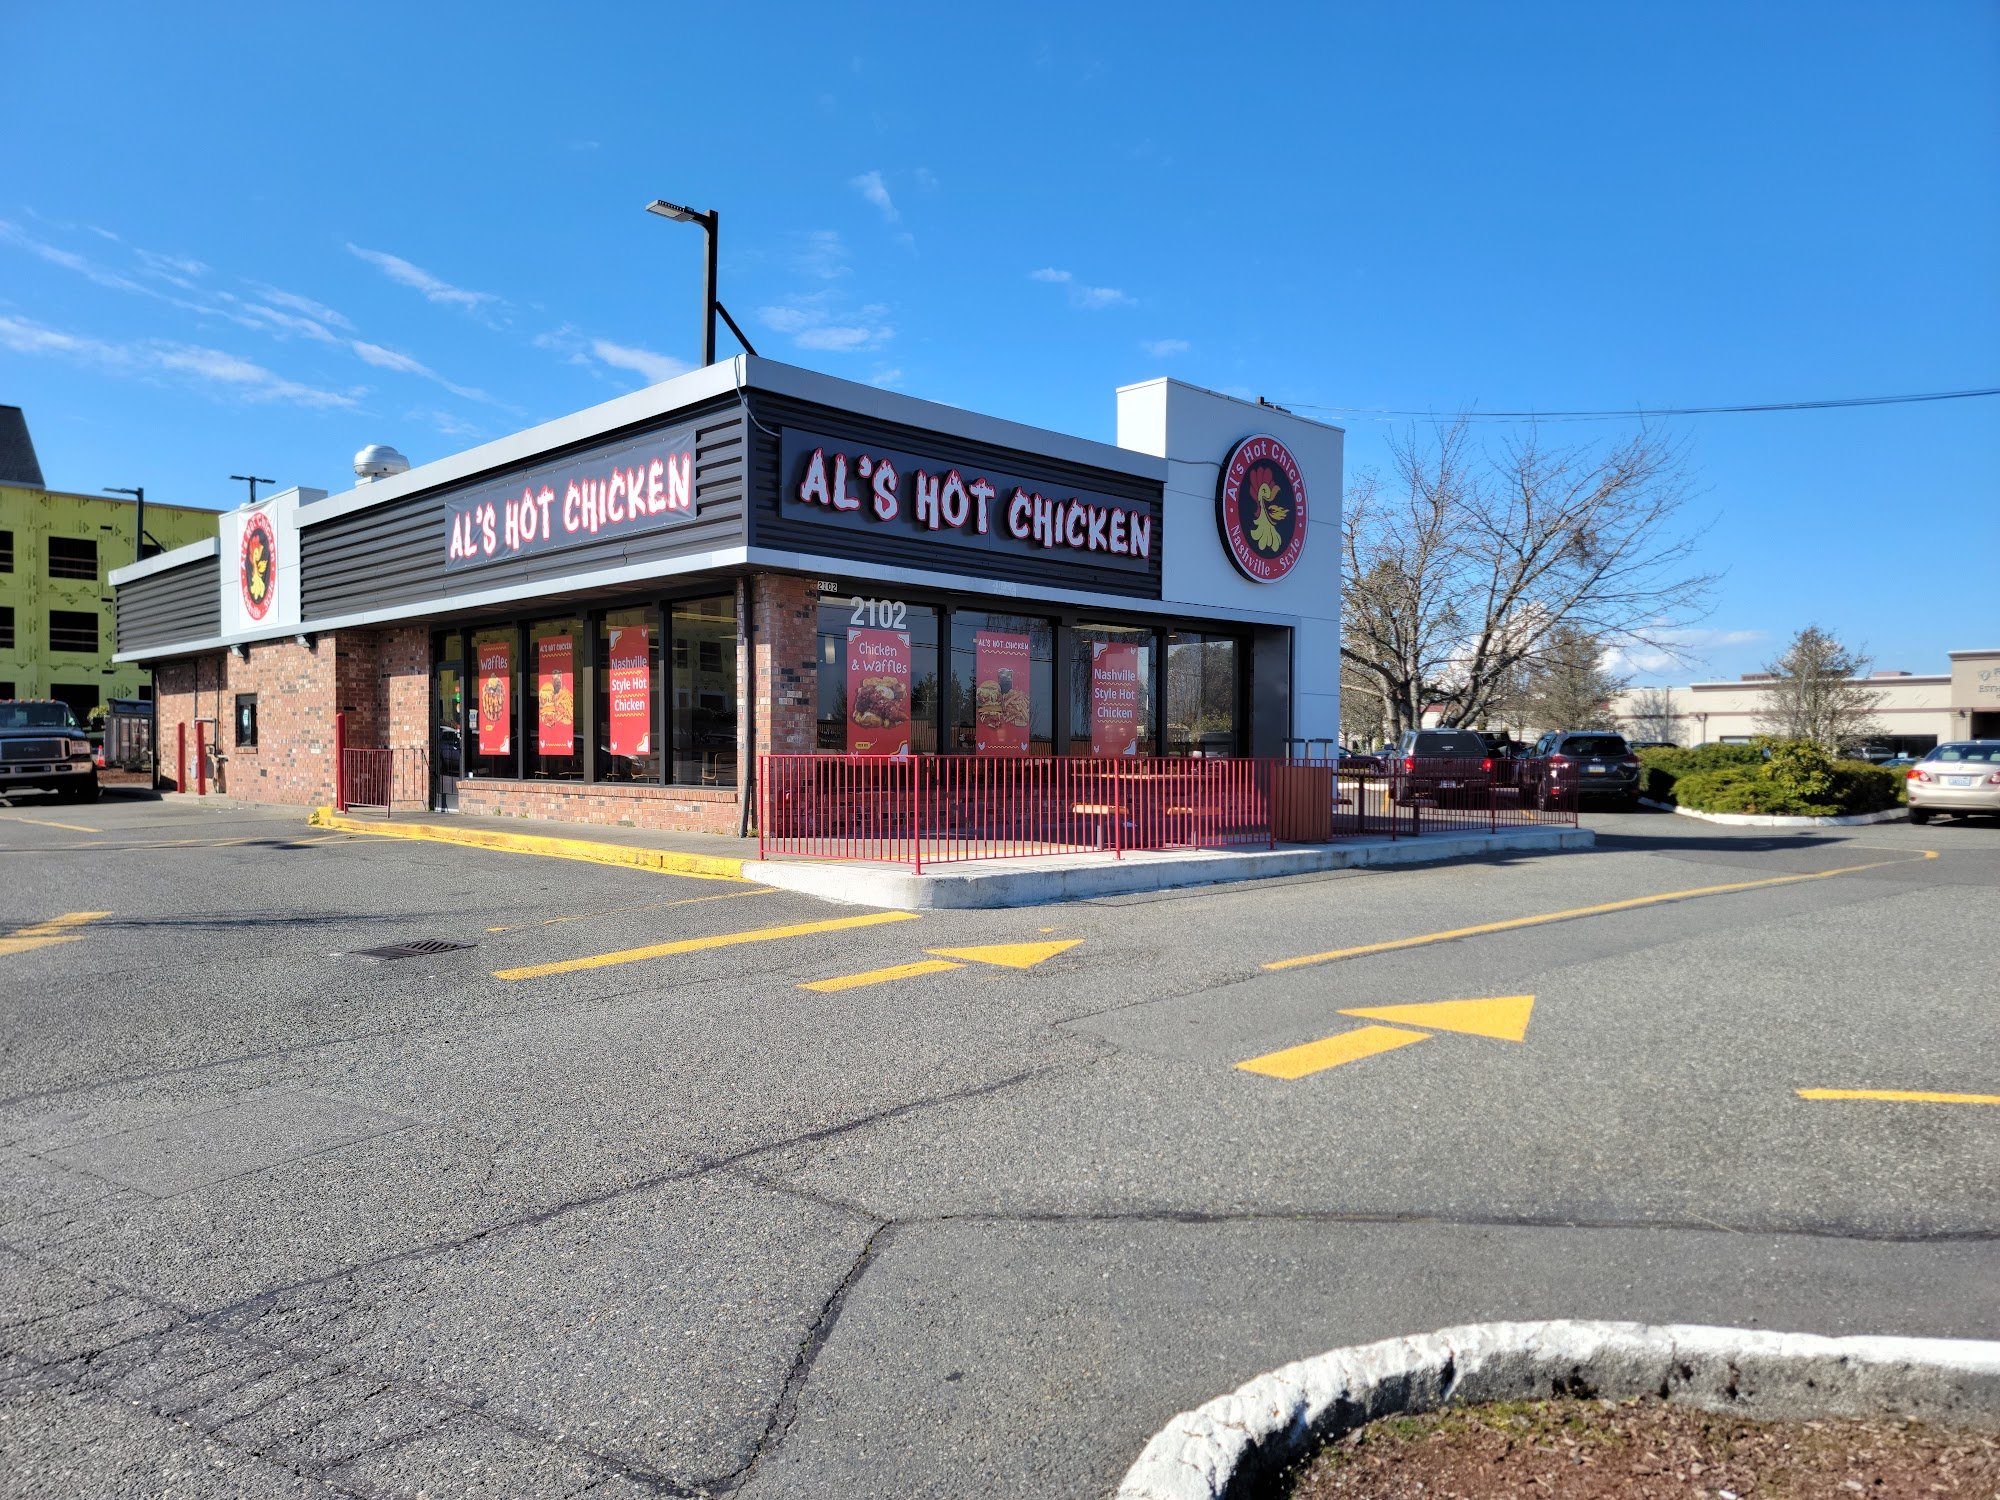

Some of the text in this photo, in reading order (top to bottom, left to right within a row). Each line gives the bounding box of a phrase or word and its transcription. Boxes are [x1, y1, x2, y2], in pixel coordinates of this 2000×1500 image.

[1227, 440, 1304, 516] Al's Hot Chicken
[450, 452, 692, 560] AL'S HOT CHICKEN
[800, 447, 1152, 560] AL'S HOT CHICKEN
[1230, 525, 1270, 577] Nashville
[1279, 538, 1300, 571] Style
[818, 582, 837, 592] 2102
[850, 596, 907, 630] 2102
[859, 641, 897, 657] Chicken
[1005, 642, 1029, 650] CHICKEN
[611, 656, 647, 670] Nashville
[851, 659, 860, 671] &
[1094, 668, 1136, 682] Nashville
[611, 677, 647, 693] Style Hot
[1094, 687, 1135, 701] Style Hot
[614, 698, 645, 712] Chicken
[1097, 706, 1133, 718] Chicken
